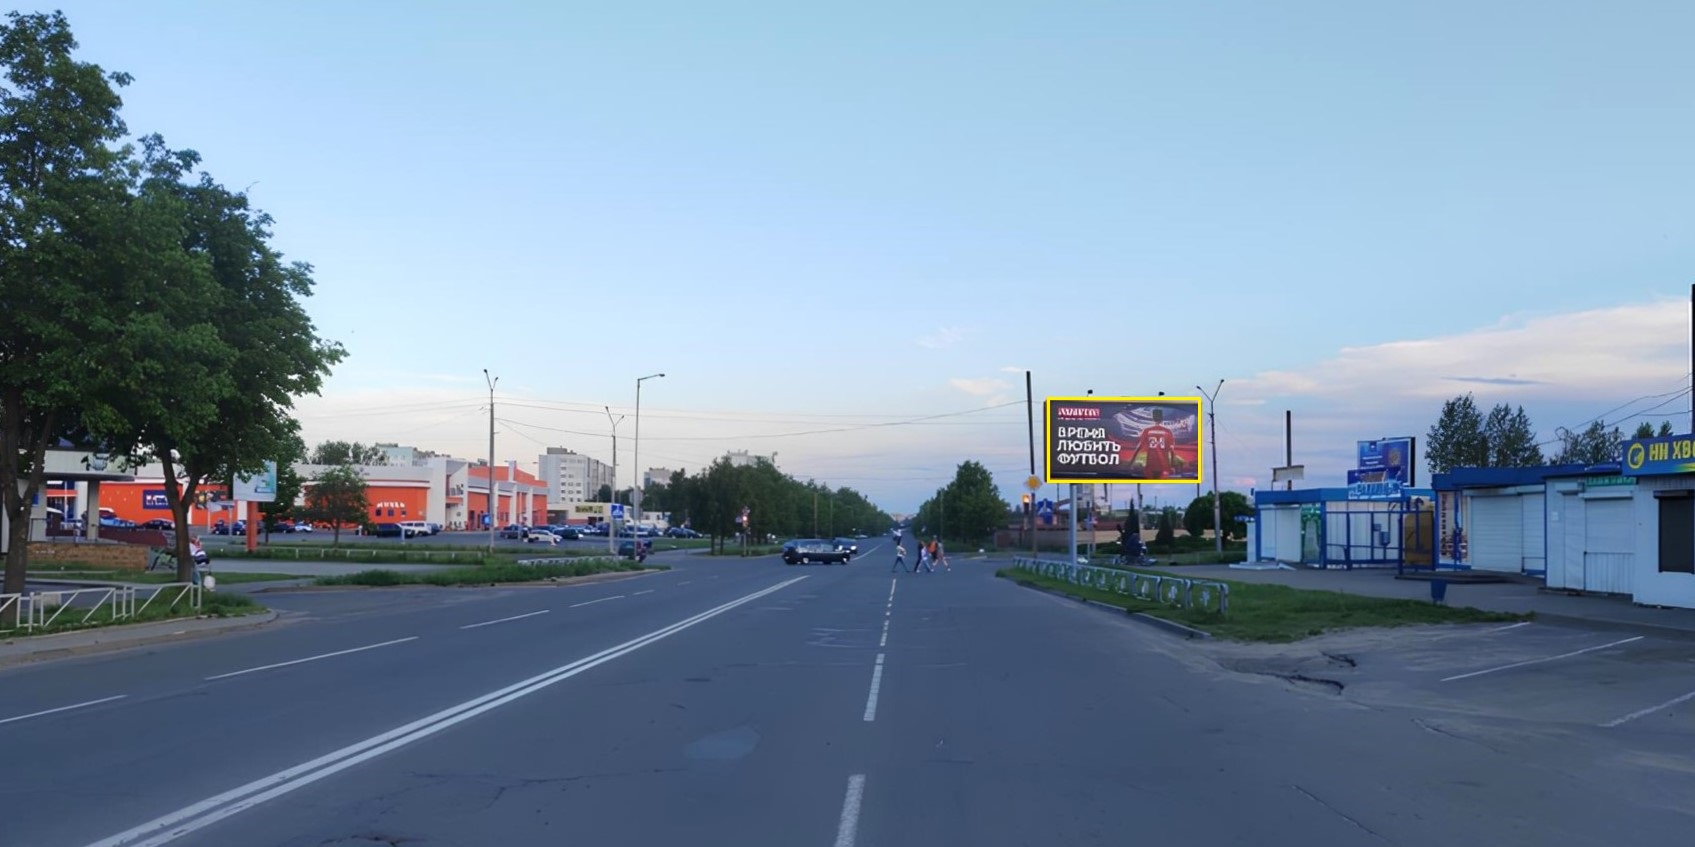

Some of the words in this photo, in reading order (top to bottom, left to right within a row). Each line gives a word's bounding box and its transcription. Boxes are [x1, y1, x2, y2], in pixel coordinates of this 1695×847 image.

[1058, 426, 1106, 438] ВРЕМЯ
[1057, 439, 1121, 452] ЛЮБИТЬ
[1057, 453, 1120, 465] ФУТБОЛ
